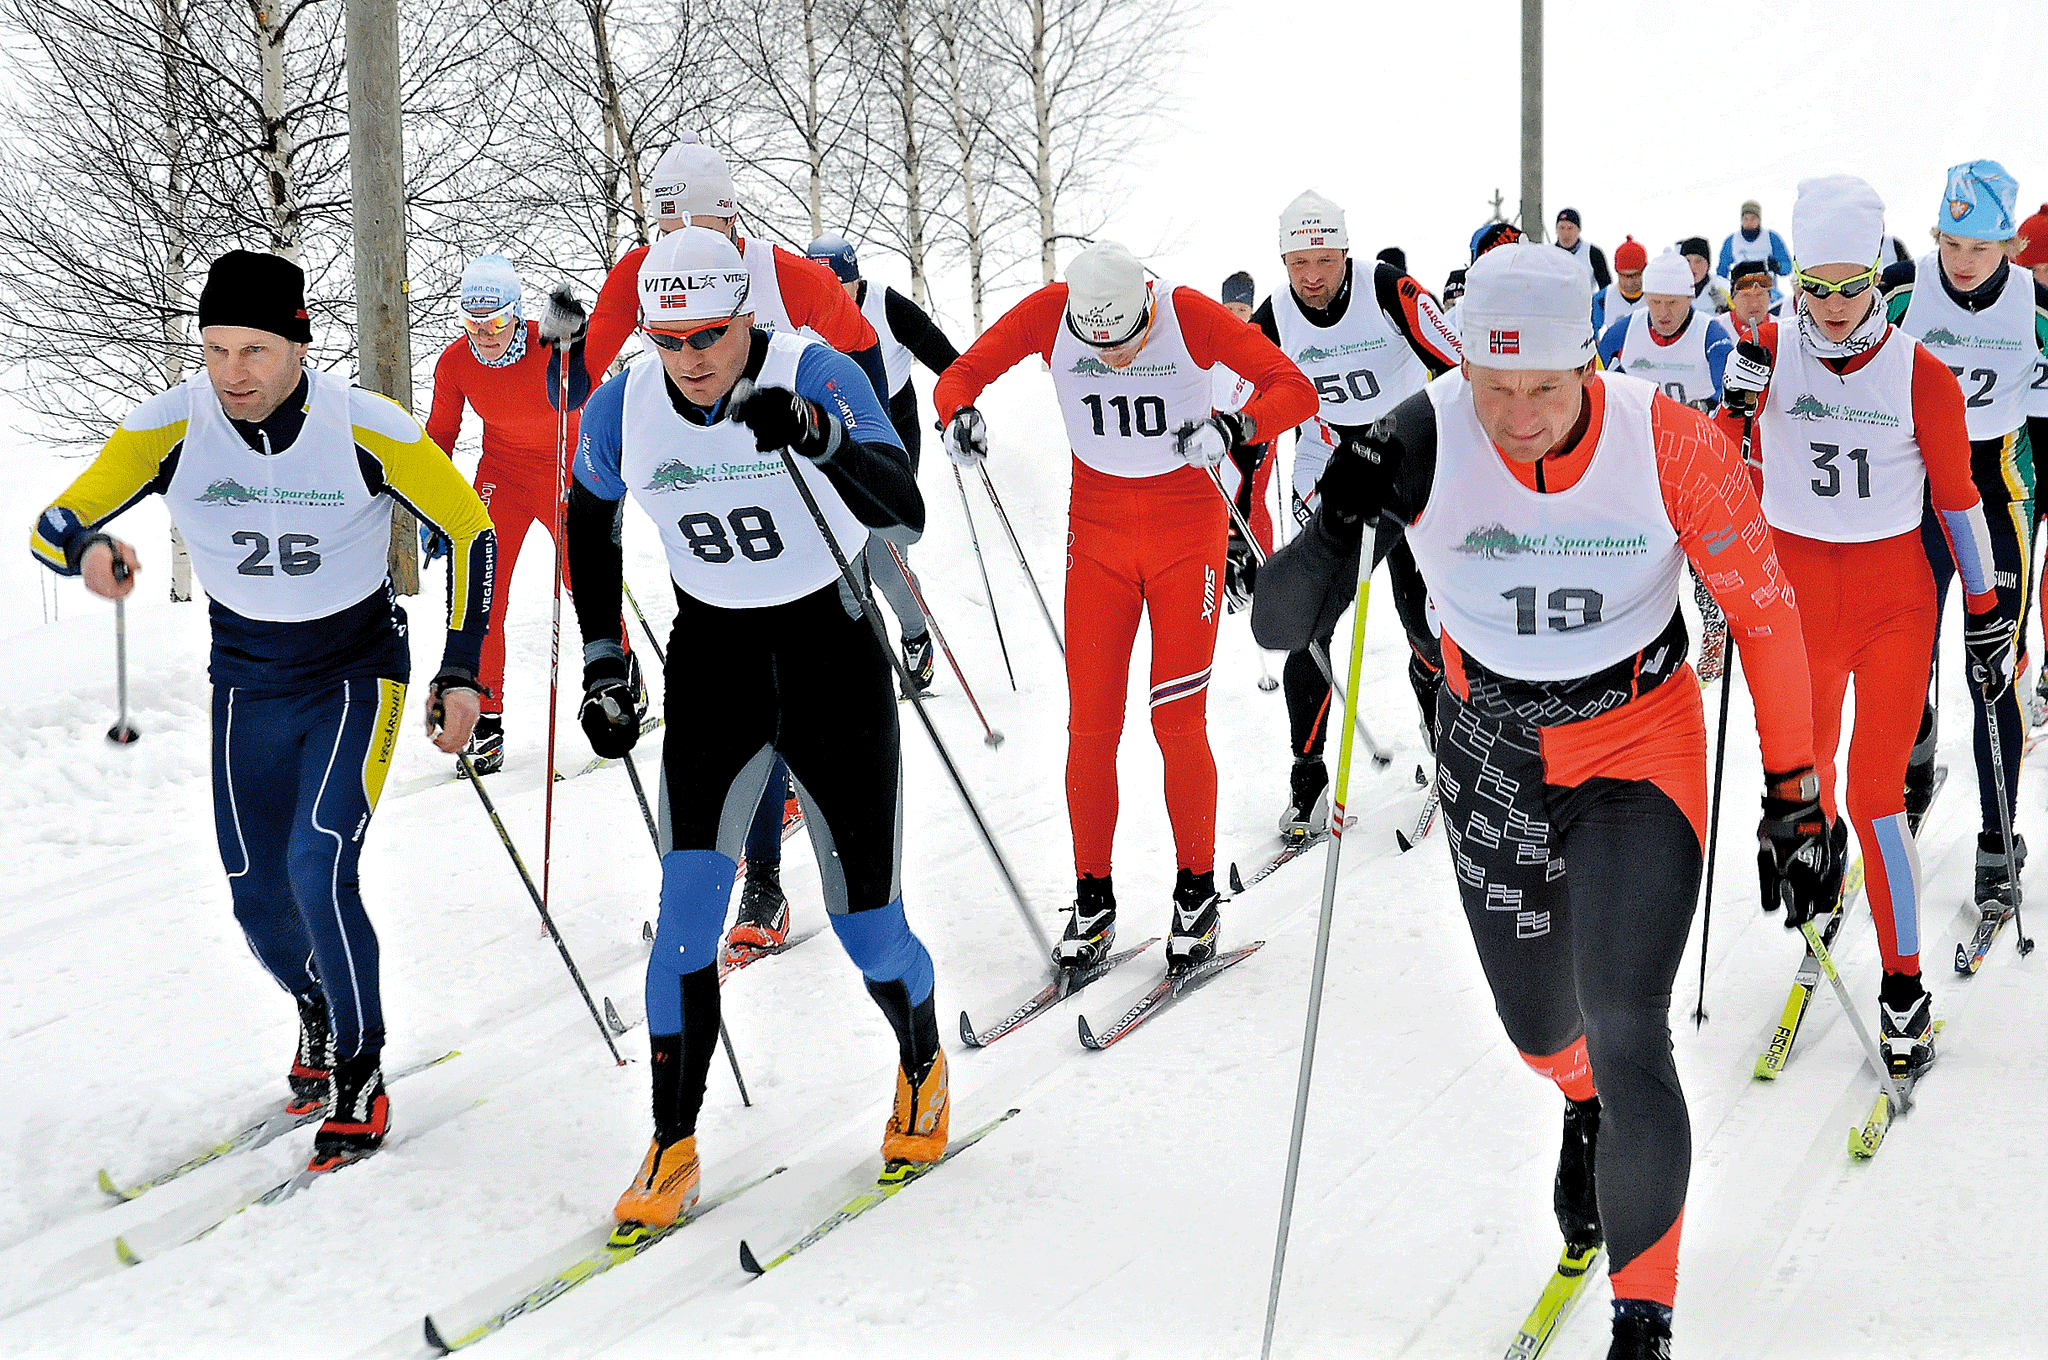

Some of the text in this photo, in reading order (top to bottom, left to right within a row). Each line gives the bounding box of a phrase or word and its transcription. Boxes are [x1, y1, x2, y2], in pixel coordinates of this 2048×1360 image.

[644, 276, 700, 292] VITAL
[1419, 301, 1462, 356] MARCIALONG
[1739, 357, 1762, 372] CRAFT
[1313, 369, 1381, 404] 50
[1081, 394, 1168, 437] 110
[1844, 405, 1900, 423] Sparebank
[720, 461, 785, 476] Spareban
[1809, 441, 1871, 499] 31
[273, 487, 345, 502] Sparebank
[231, 531, 321, 576] 26
[678, 506, 785, 564] 88
[1554, 534, 1647, 549] Sparebank
[481, 542, 493, 613] VEGÅRSHEI
[1501, 586, 1603, 635] 19
[1765, 1025, 1792, 1070] FISCHER
